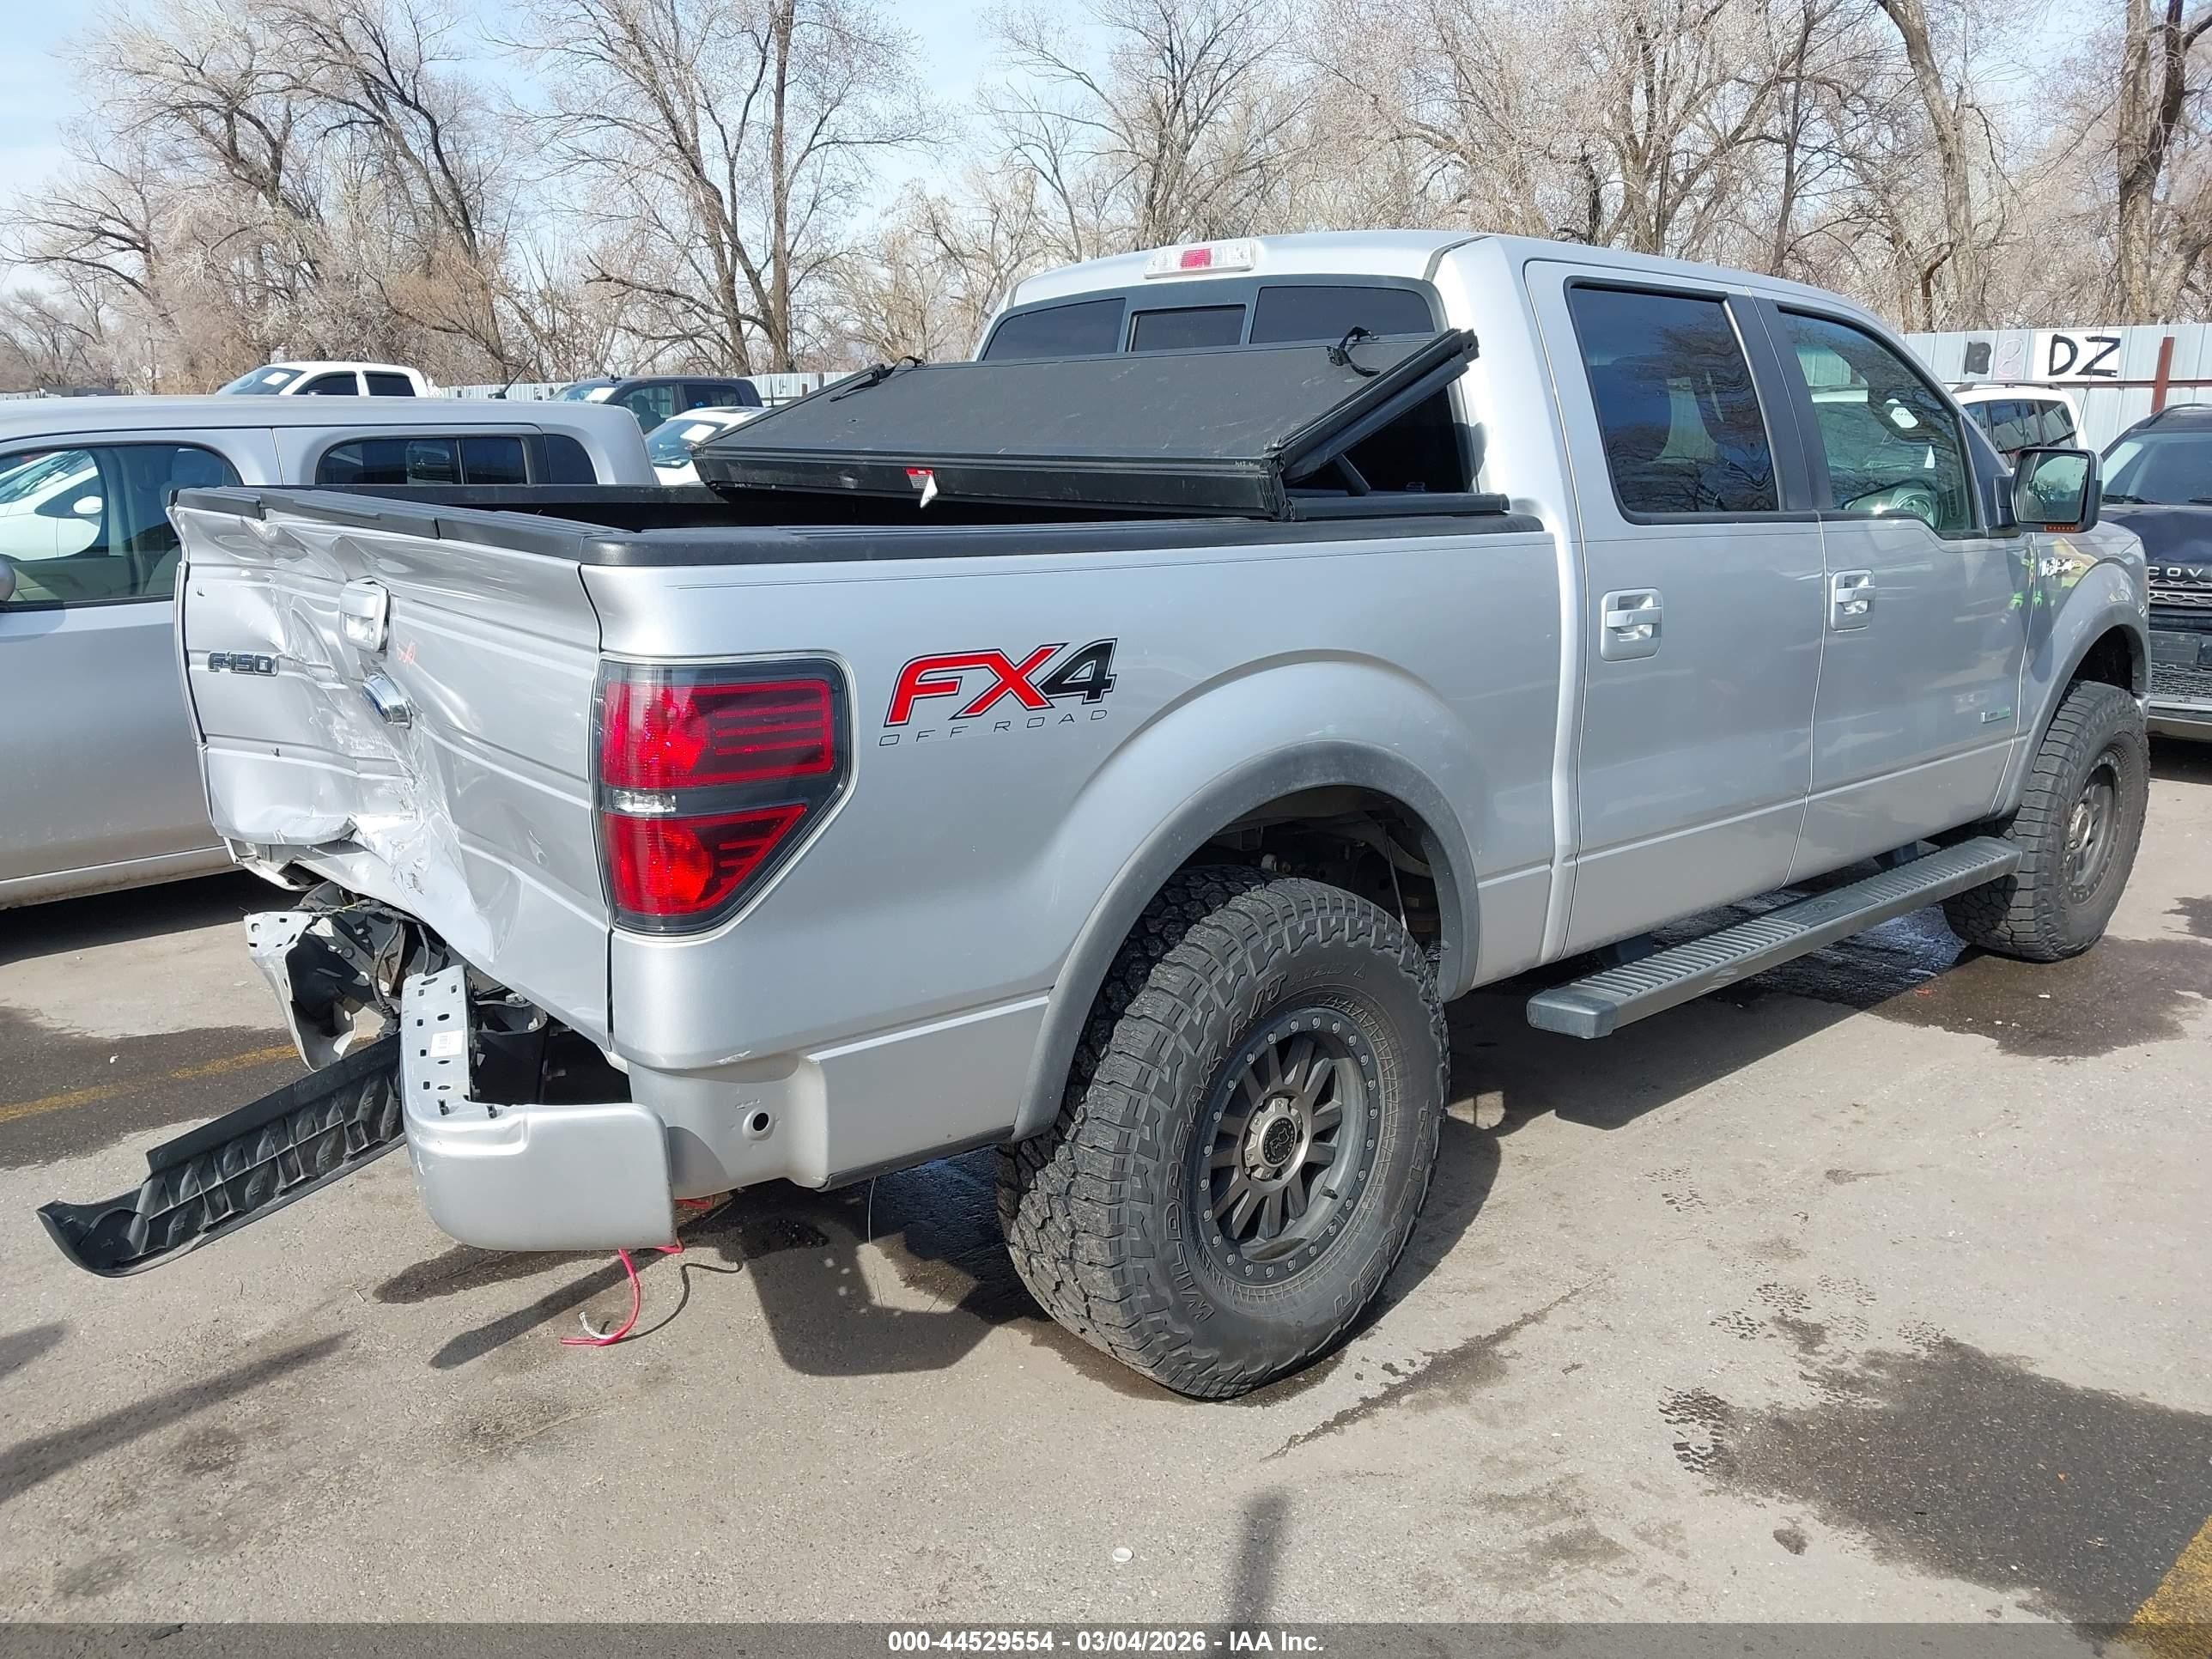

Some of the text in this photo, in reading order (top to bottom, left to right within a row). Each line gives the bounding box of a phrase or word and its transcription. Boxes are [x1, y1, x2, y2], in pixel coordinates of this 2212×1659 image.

[208, 652, 279, 677] F-150
[883, 636, 1119, 727] FX4
[879, 709, 1108, 747] OFF ROAD
